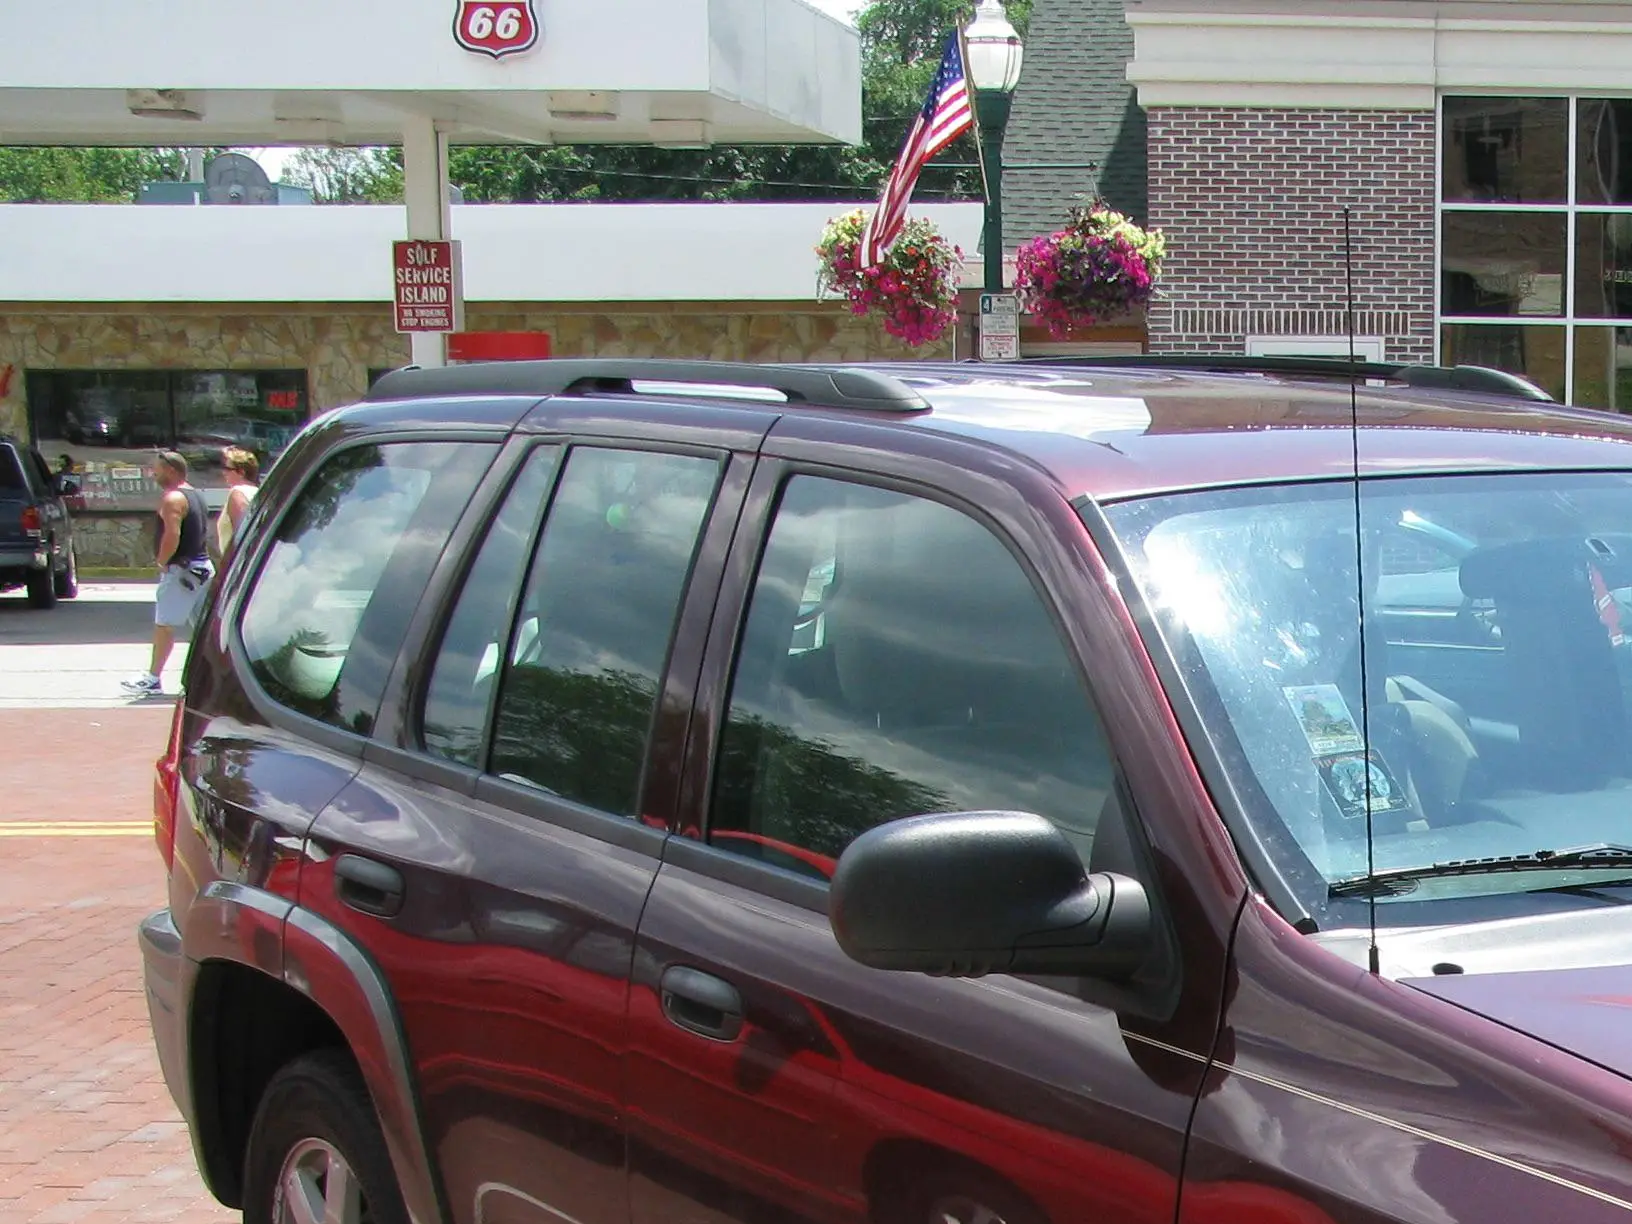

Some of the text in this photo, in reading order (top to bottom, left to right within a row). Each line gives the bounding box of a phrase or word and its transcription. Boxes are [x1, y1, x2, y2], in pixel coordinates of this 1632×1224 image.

[468, 7, 522, 39] 66
[396, 267, 450, 284] SERVICE
[400, 286, 448, 303] ISLAND
